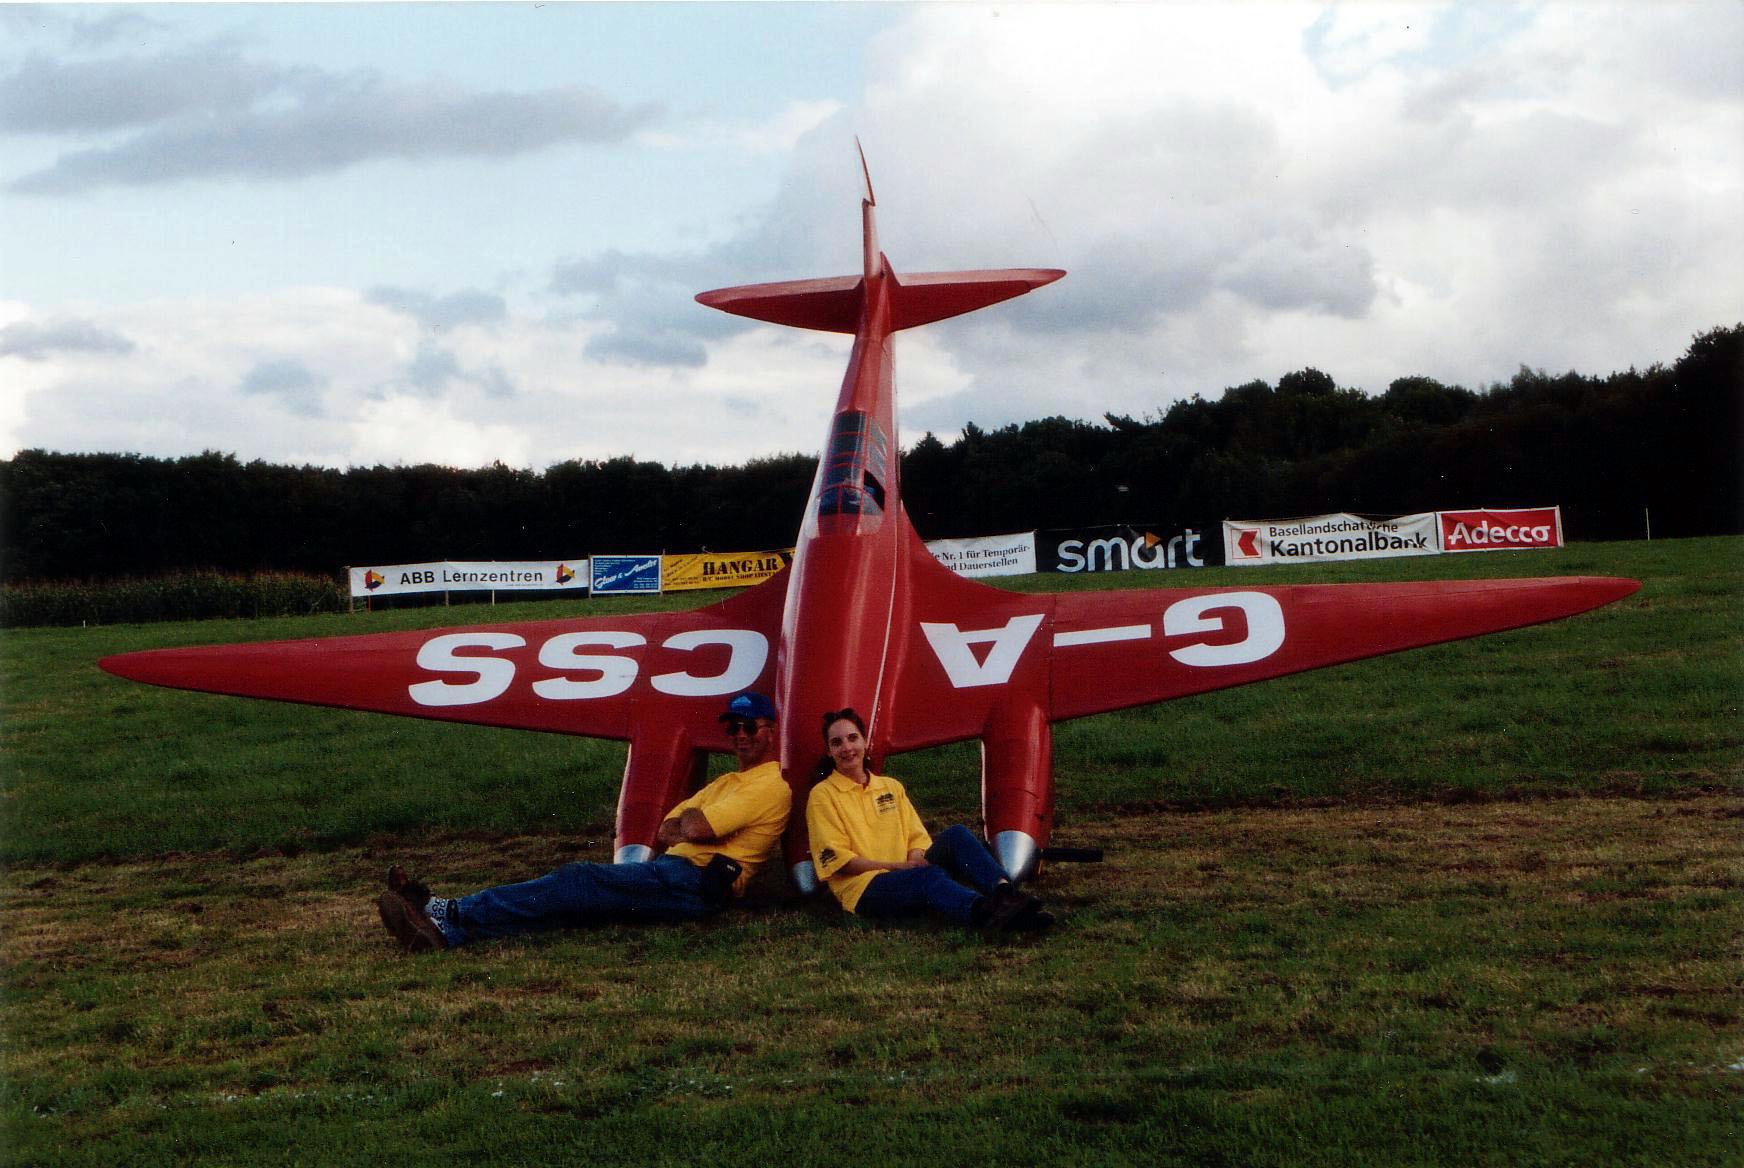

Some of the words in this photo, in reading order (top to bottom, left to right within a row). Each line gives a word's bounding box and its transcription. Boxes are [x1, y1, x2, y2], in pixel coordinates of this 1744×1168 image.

[1447, 520, 1551, 545] Adecco
[942, 551, 956, 561] Nr.
[959, 551, 963, 560] 1
[966, 550, 980, 559] für
[983, 544, 1031, 558] Temporär-
[1056, 528, 1204, 573] smart
[1270, 531, 1428, 557] Kantonalbank
[703, 558, 778, 576] HANGAR
[959, 557, 1018, 571] Dauerstellen
[400, 571, 435, 585] ABB
[443, 569, 543, 583] Lernzentren
